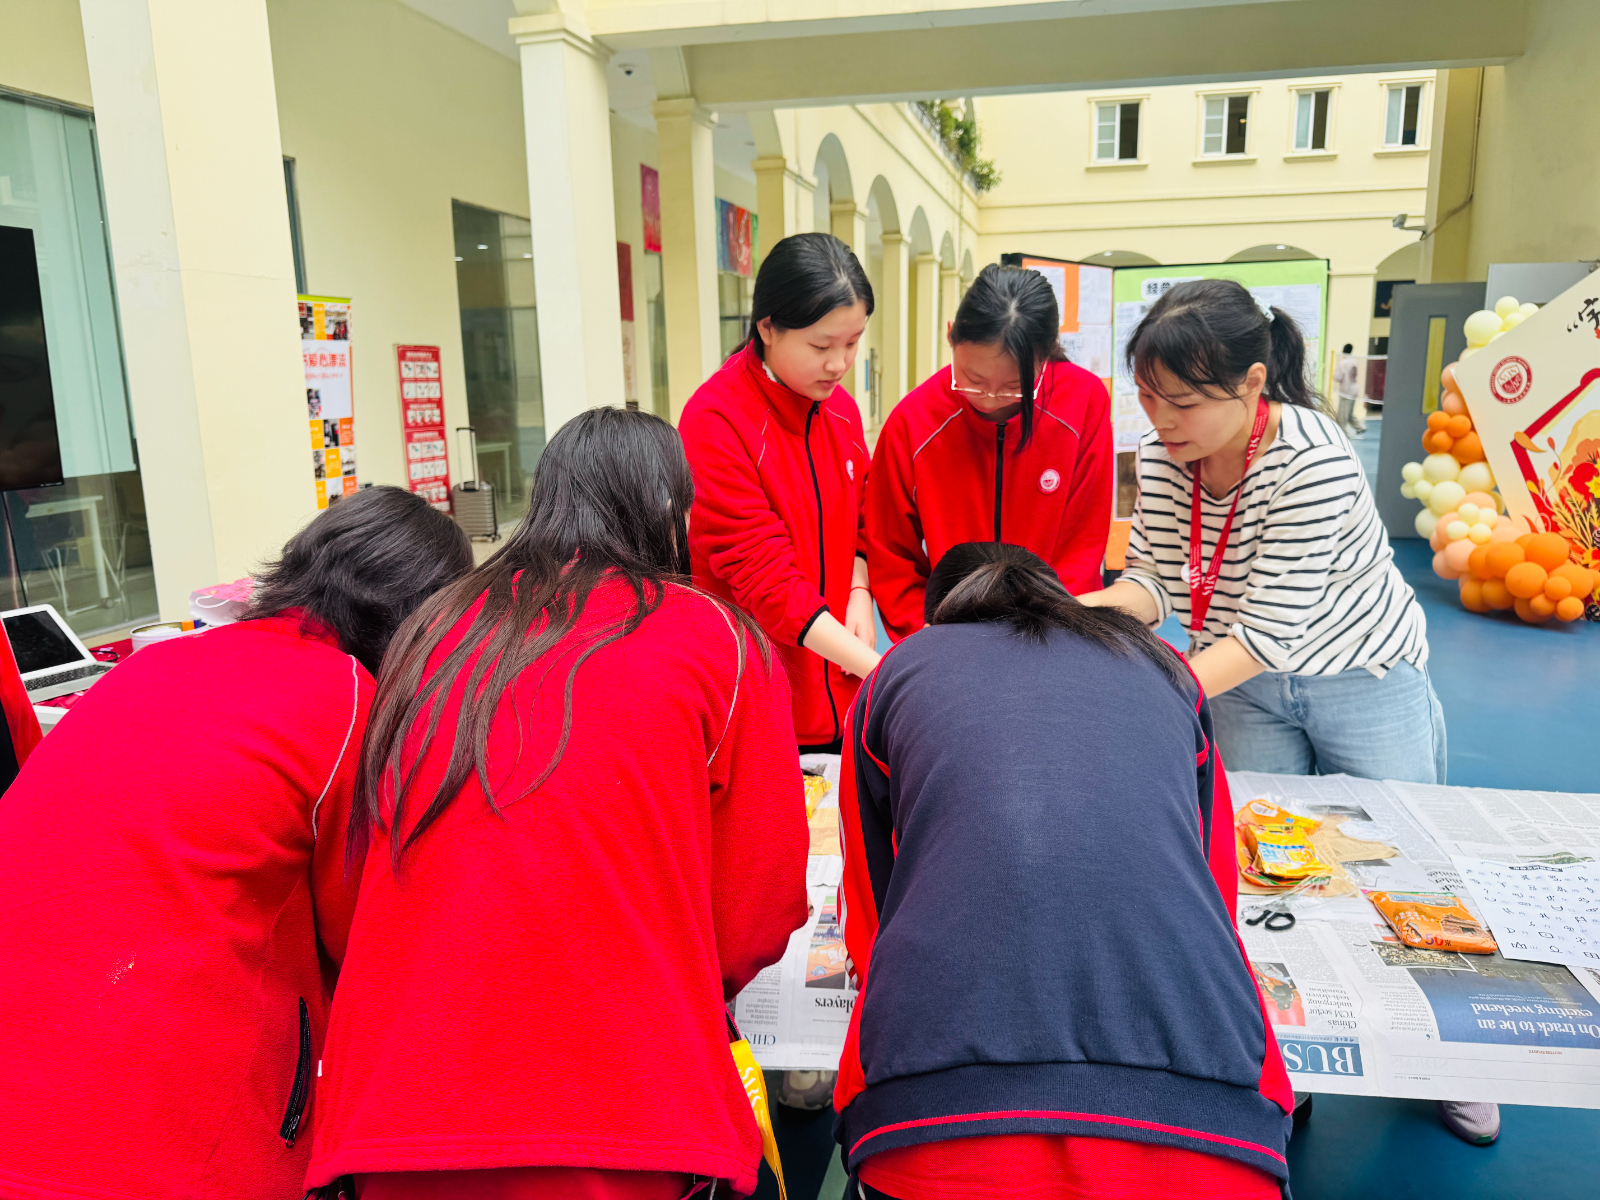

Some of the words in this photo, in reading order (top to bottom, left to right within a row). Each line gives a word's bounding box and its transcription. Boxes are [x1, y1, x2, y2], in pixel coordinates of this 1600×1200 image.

[1334, 1010, 1356, 1019] TCM
[1470, 1002, 1535, 1016] weekend
[1533, 1004, 1593, 1018] exciting
[1328, 1020, 1357, 1030] China's
[1476, 1018, 1496, 1030] an
[1498, 1020, 1519, 1035] be
[1519, 1020, 1536, 1032] to
[1536, 1021, 1576, 1036] track
[1577, 1023, 1600, 1038] On
[740, 1033, 776, 1046] CHIN
[1281, 1042, 1358, 1074] BUS
